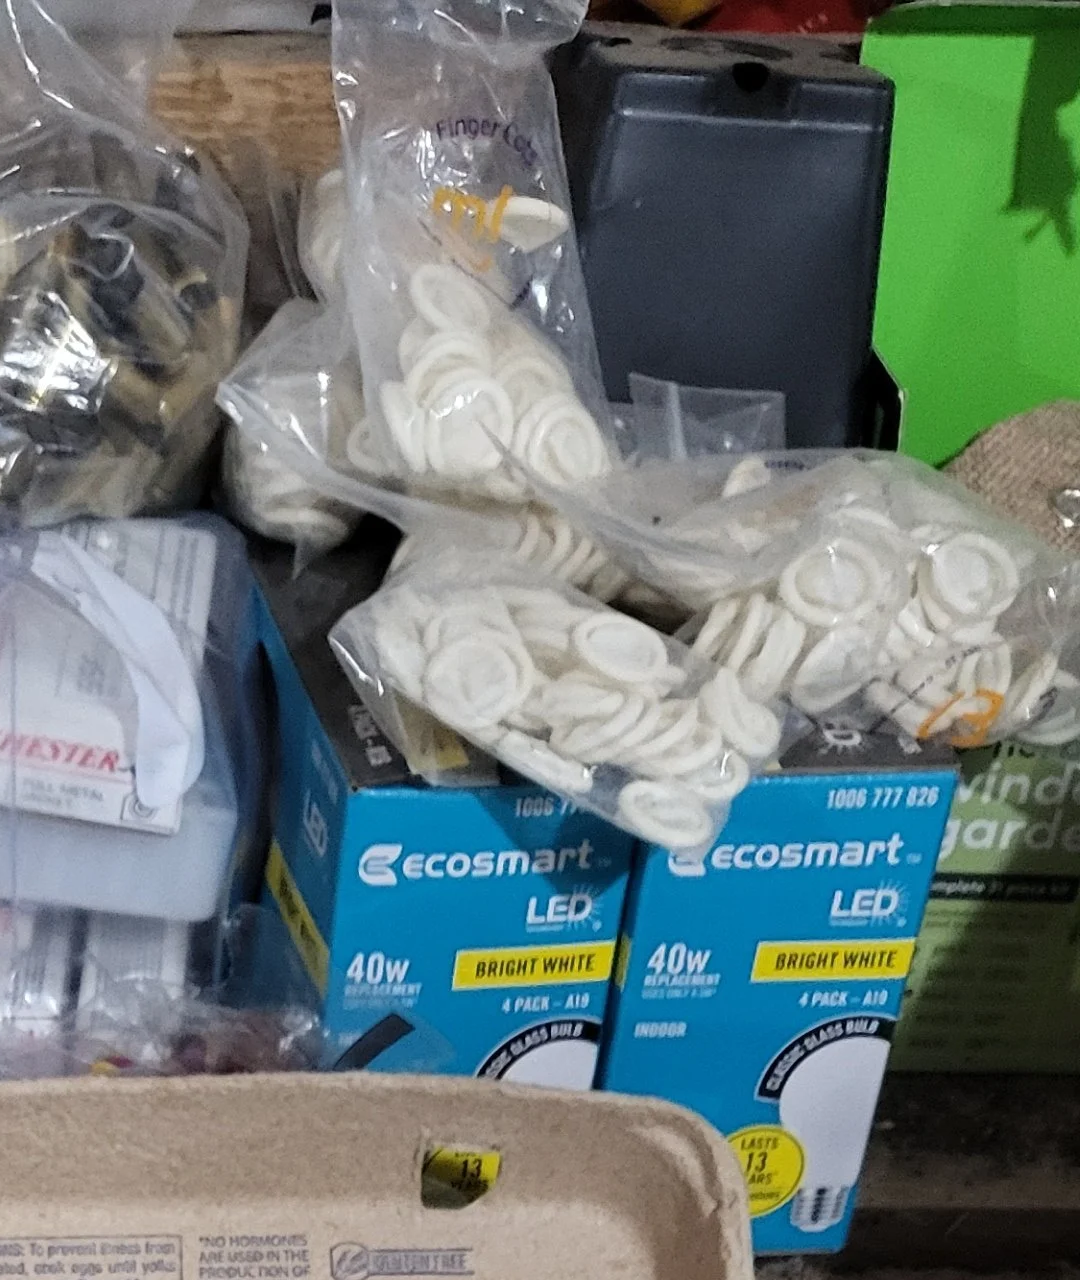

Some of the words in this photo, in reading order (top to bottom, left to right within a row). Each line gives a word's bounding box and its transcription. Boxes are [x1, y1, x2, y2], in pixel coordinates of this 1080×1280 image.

[827, 789, 867, 810] 1006
[871, 786, 904, 808] 777
[906, 785, 939, 807] 826
[402, 838, 595, 880] ecosmart
[711, 831, 905, 869] ecosmart
[525, 893, 595, 925] LED
[829, 888, 900, 918] LED
[475, 957, 538, 980] BRIGHT
[542, 952, 597, 975] WHITE
[775, 951, 838, 970] BRIGHT
[842, 949, 898, 969] WHITE
[514, 996, 550, 1014] PACK
[811, 991, 849, 1007] PACK
[549, 1022, 586, 1041] BULB
[634, 1021, 688, 1039] INDOOR
[803, 1022, 845, 1052] GLASS
[845, 1019, 880, 1036] BULB
[740, 1137, 779, 1150] LASTS
[746, 1152, 769, 1174] 13
[228, 1234, 309, 1248] HORMONES
[198, 1250, 225, 1264] ARE
[226, 1249, 265, 1263] USED
[266, 1249, 282, 1262] IN
[282, 1248, 310, 1262] THE
[198, 1265, 290, 1279] PRODUCTION
[291, 1264, 312, 1278] OF
